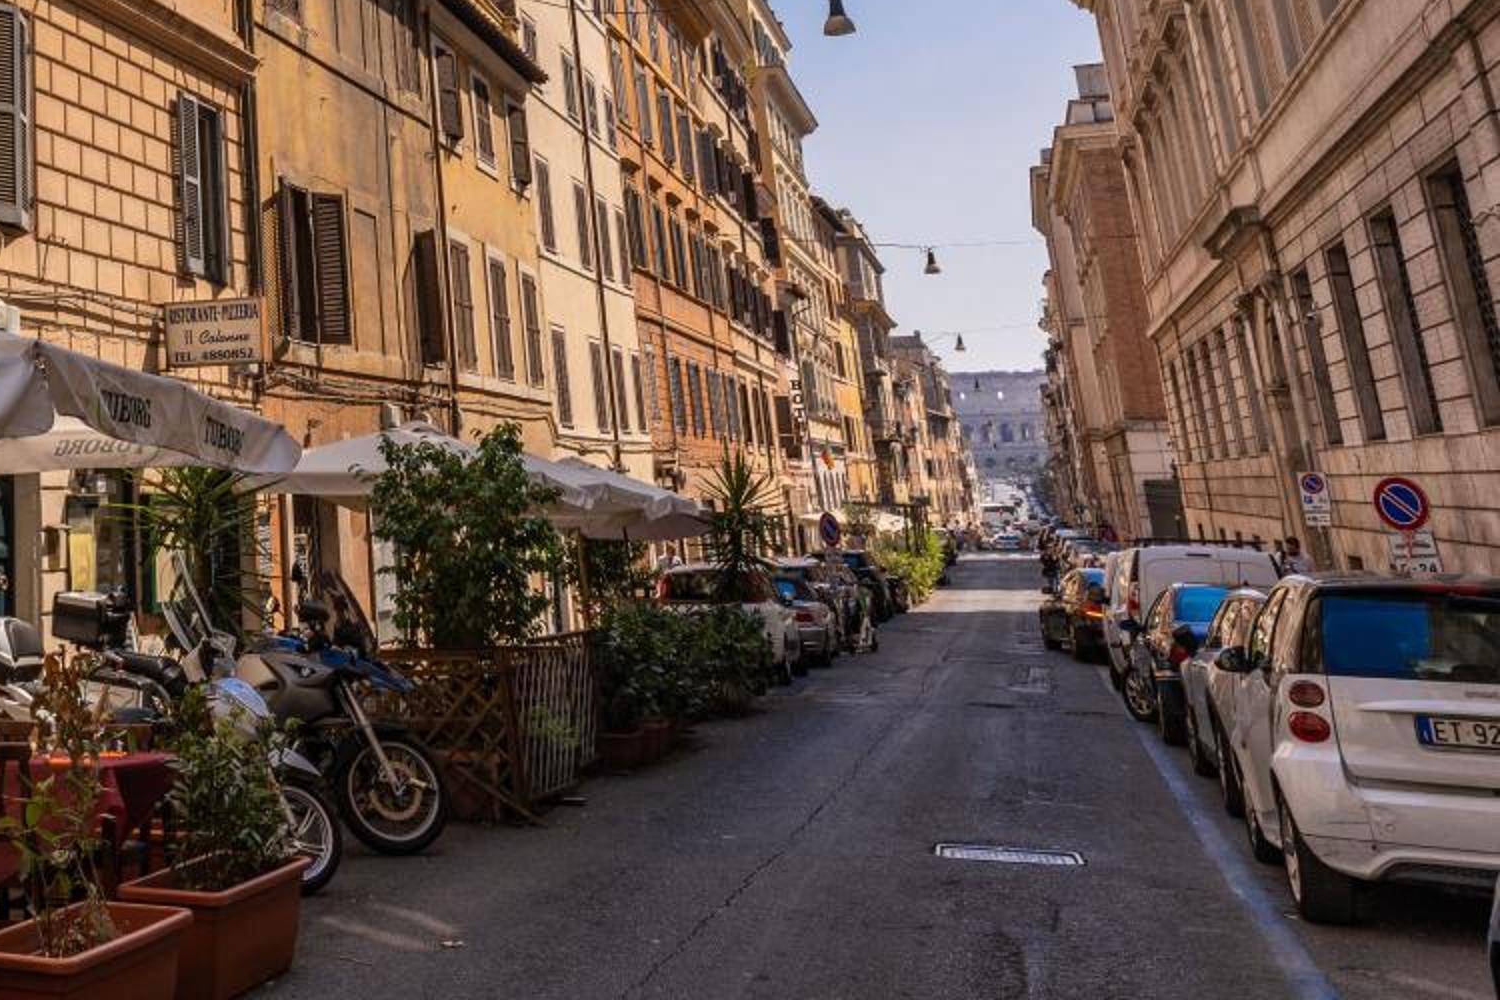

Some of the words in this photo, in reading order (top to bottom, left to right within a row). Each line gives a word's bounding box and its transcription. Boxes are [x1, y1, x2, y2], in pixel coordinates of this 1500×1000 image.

[175, 352, 197, 363] TEL.
[1434, 722, 1460, 742] ET
[1473, 724, 1500, 745] 92
